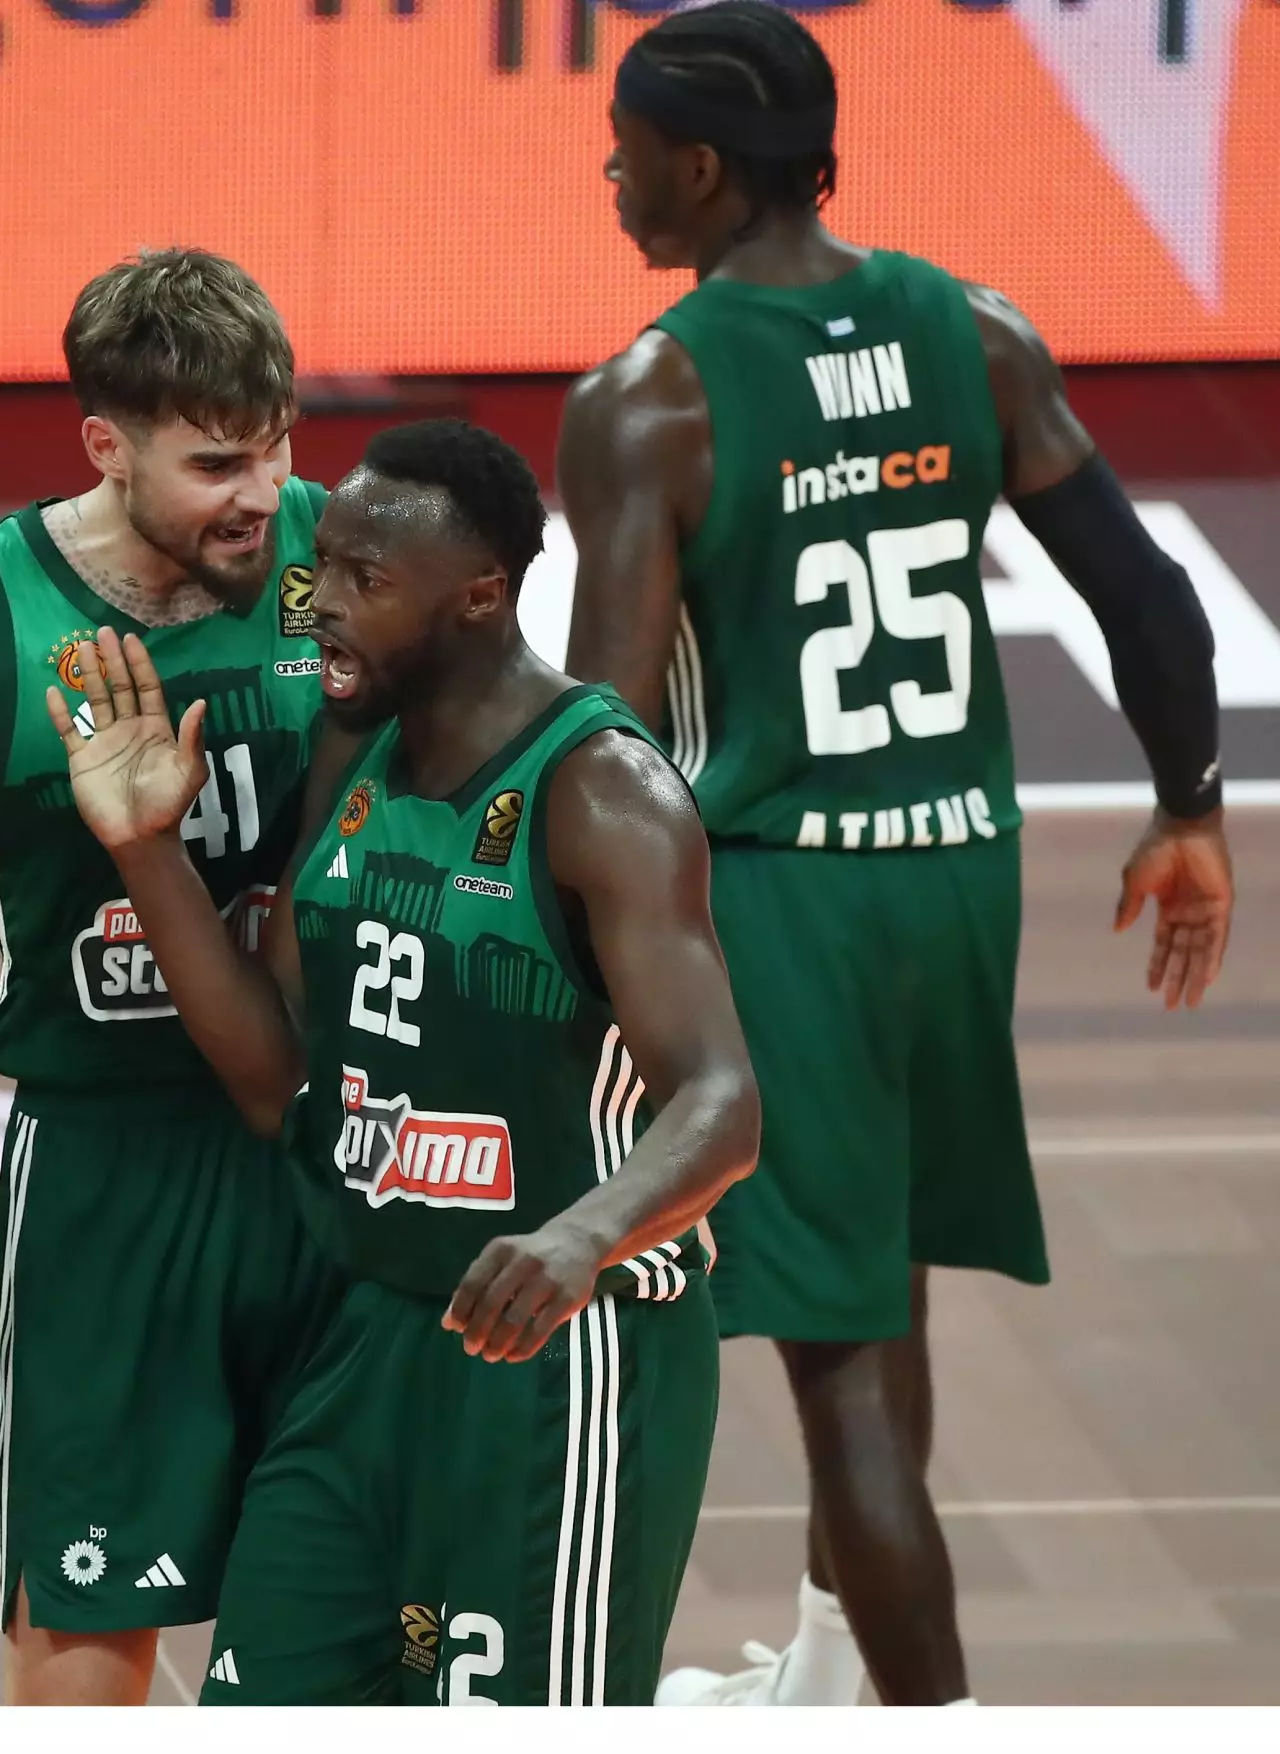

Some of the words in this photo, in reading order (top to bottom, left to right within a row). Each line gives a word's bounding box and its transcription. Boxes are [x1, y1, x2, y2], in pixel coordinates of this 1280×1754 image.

[795, 518, 972, 755] 25
[180, 743, 260, 858] 41
[797, 787, 997, 849] ATHENS
[455, 876, 513, 899] oneteam
[349, 920, 425, 1048] 22
[90, 1524, 107, 1541] bp
